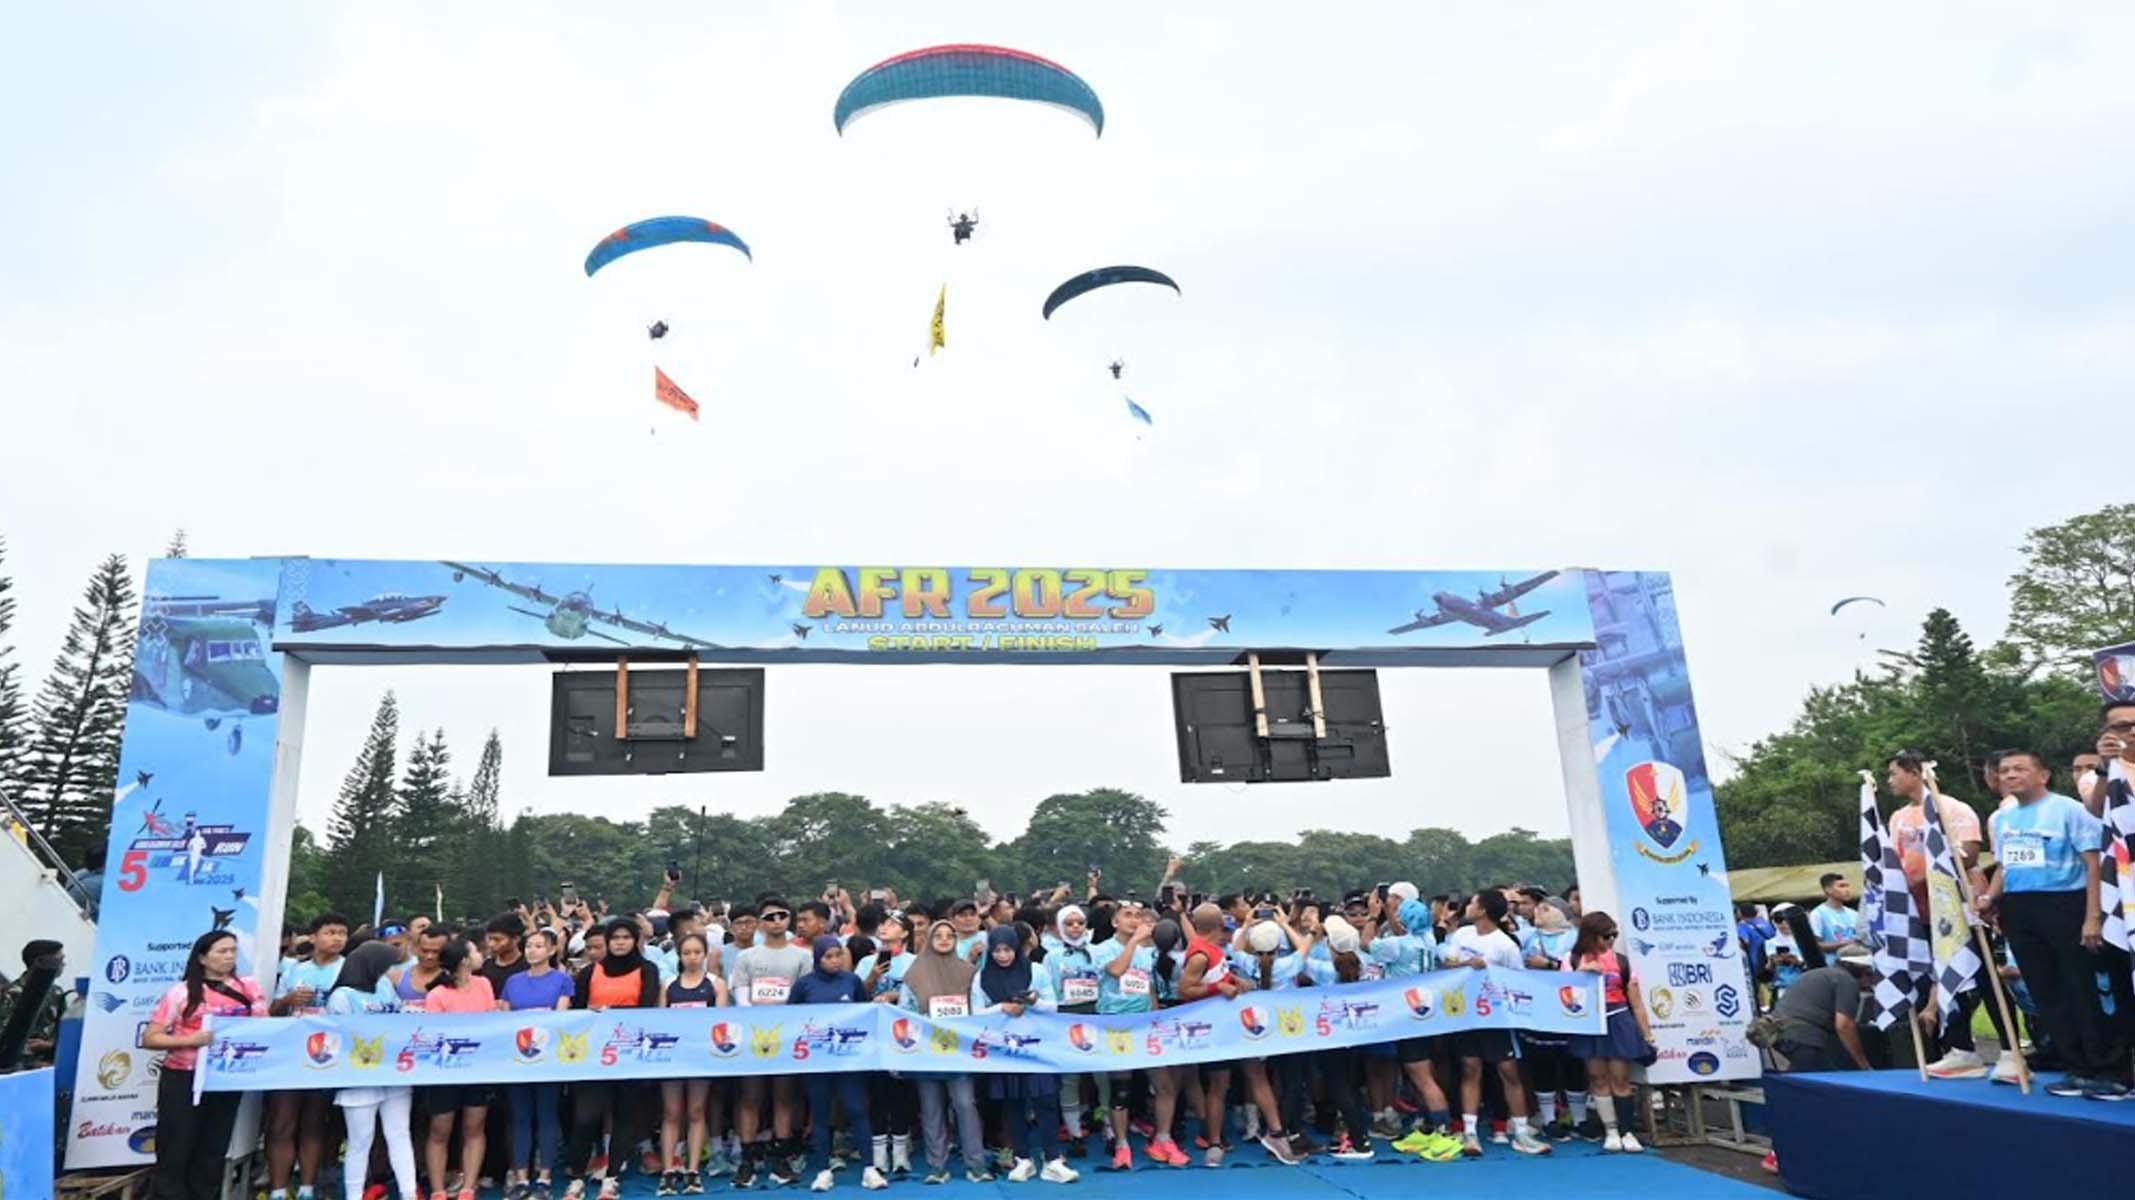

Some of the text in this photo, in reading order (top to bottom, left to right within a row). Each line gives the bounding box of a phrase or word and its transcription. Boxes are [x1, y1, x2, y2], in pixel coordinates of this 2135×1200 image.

[803, 568, 1155, 618] AFR 2025
[823, 623, 894, 634] LANUD
[1074, 623, 1139, 634] SALEH
[867, 636, 974, 651] START
[998, 636, 1097, 651] FINISH
[117, 850, 149, 892] 5
[133, 961, 168, 975] BANK
[1686, 964, 1713, 984] BRI
[1476, 997, 1492, 1017] 5
[1315, 1018, 1332, 1036] 5
[601, 1045, 618, 1066] 5
[793, 1040, 810, 1060] 5
[971, 1041, 988, 1059] 5
[1147, 1035, 1163, 1056] 5
[397, 1052, 416, 1072] 5
